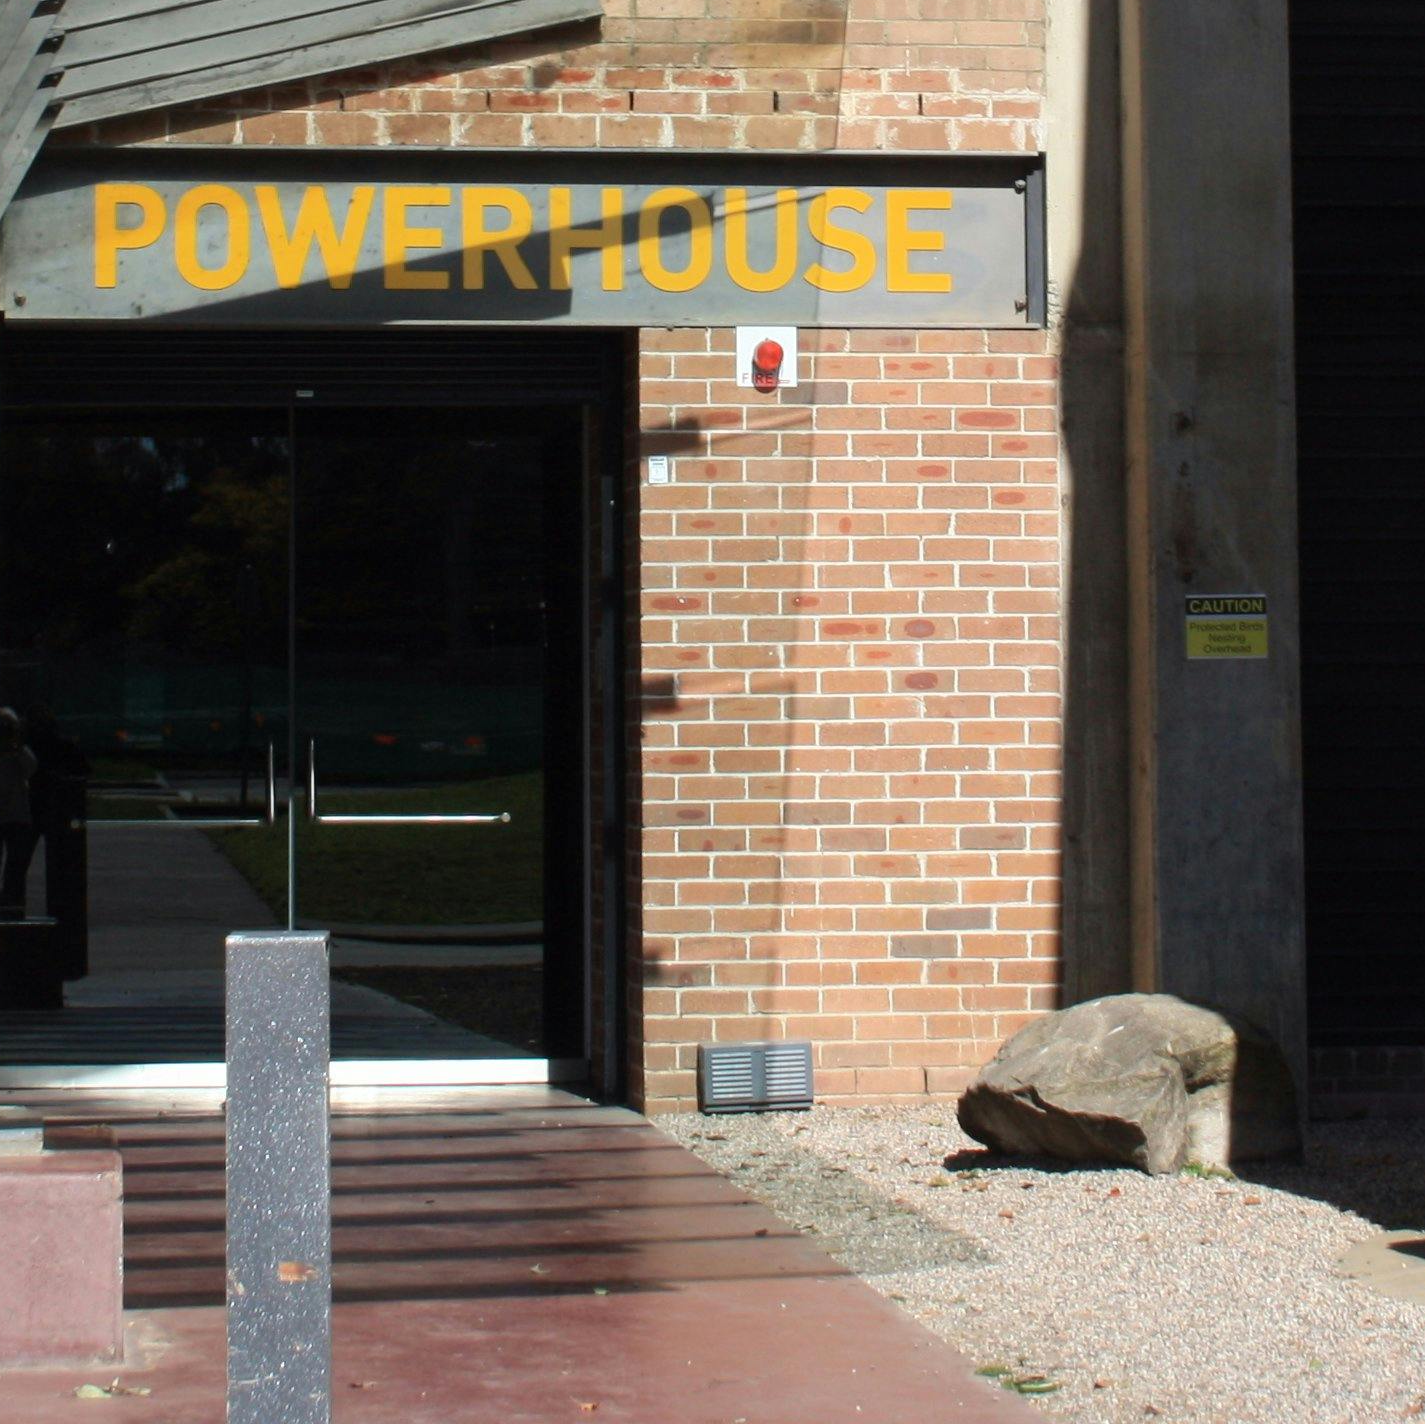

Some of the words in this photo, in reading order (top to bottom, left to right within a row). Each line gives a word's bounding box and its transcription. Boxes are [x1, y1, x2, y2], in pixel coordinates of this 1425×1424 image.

[95, 183, 952, 294] POWERHOUSE
[1190, 599, 1264, 613] CAUTION
[1189, 622, 1236, 632] Protected
[1239, 622, 1264, 631] Birds
[1208, 633, 1246, 644] Nesting
[1203, 644, 1252, 654] Overhead
